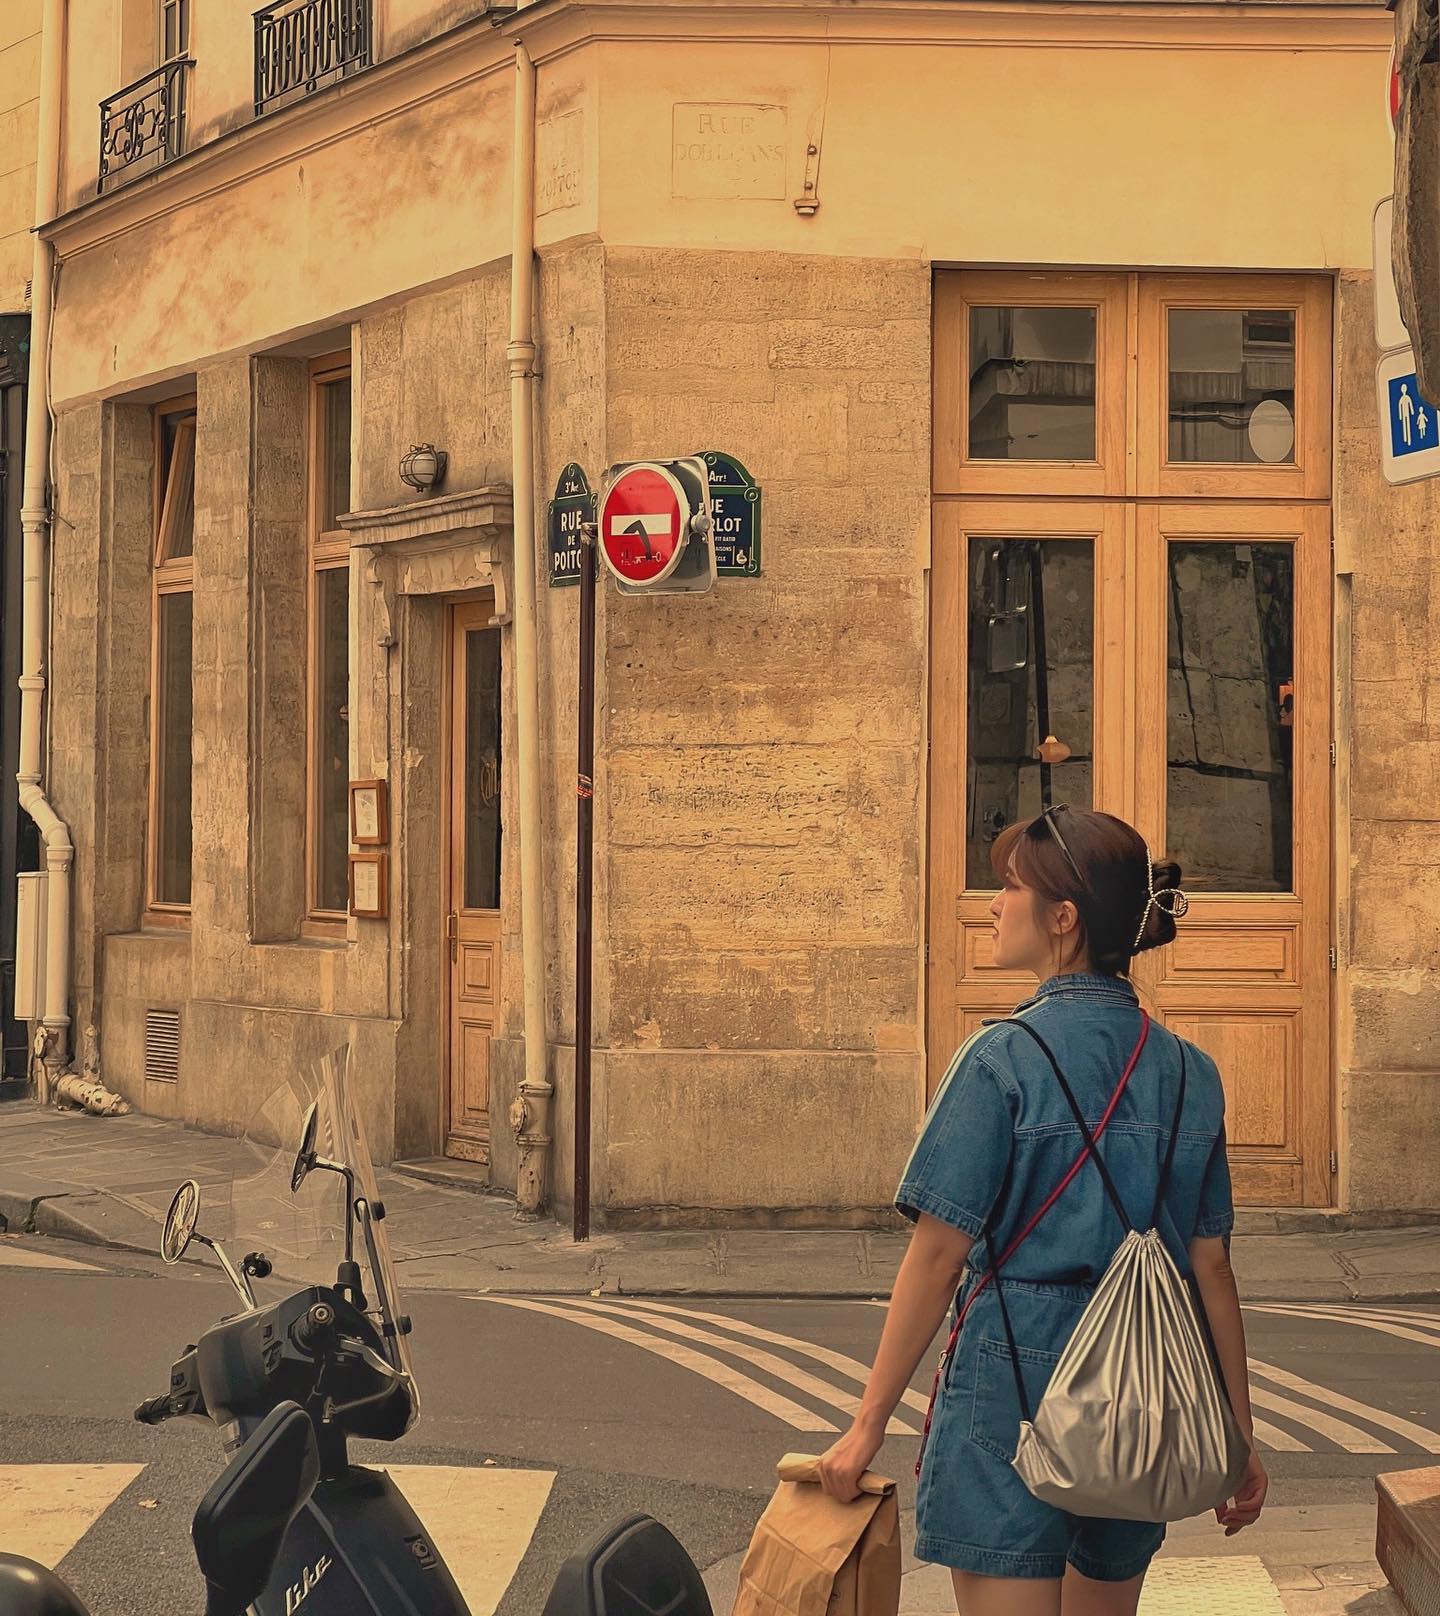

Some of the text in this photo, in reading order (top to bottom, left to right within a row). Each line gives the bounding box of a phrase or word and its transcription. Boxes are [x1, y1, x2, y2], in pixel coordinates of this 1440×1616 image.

[697, 113, 754, 134] RUE
[709, 498, 724, 513] UE
[561, 510, 582, 532] RUE
[711, 517, 742, 533] RLOT
[567, 535, 576, 546] DE
[554, 549, 582, 571] POITO
